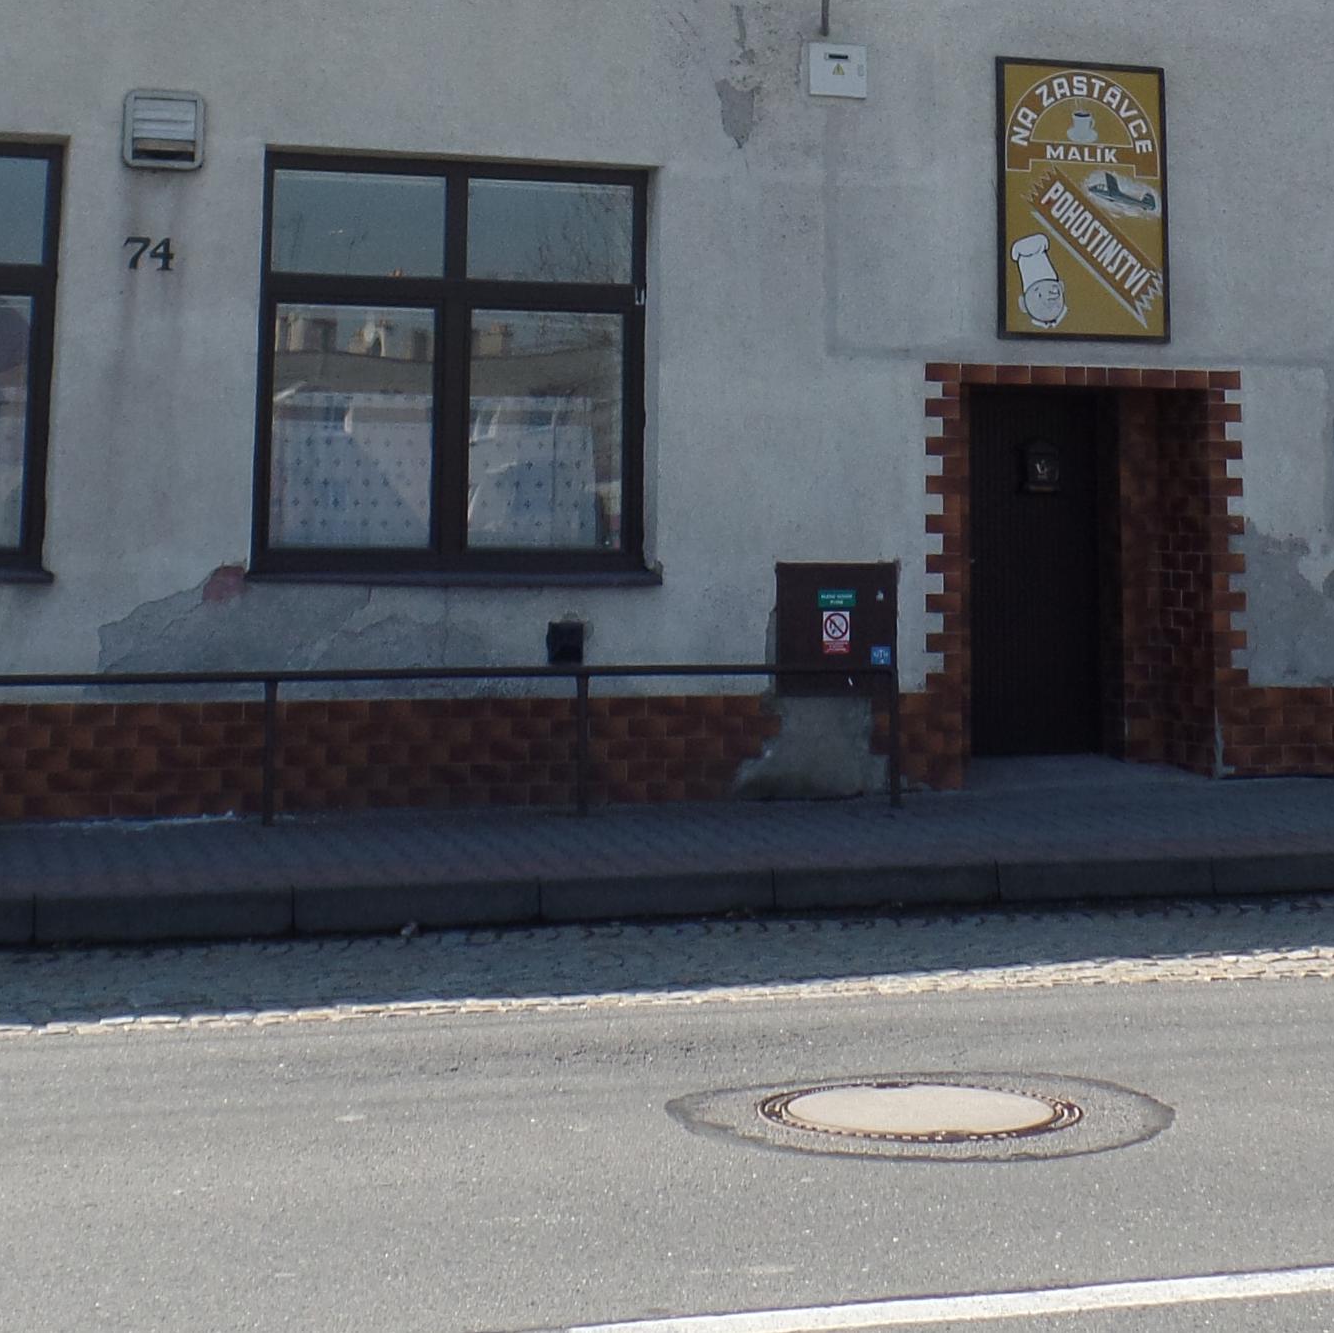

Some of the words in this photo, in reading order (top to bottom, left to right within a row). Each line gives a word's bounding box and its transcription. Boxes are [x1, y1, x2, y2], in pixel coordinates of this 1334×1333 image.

[1010, 106, 1038, 147] NA
[1035, 75, 1153, 154] ZASTÁVCE
[1046, 144, 1118, 163] MALÍK
[123, 236, 175, 271] 74
